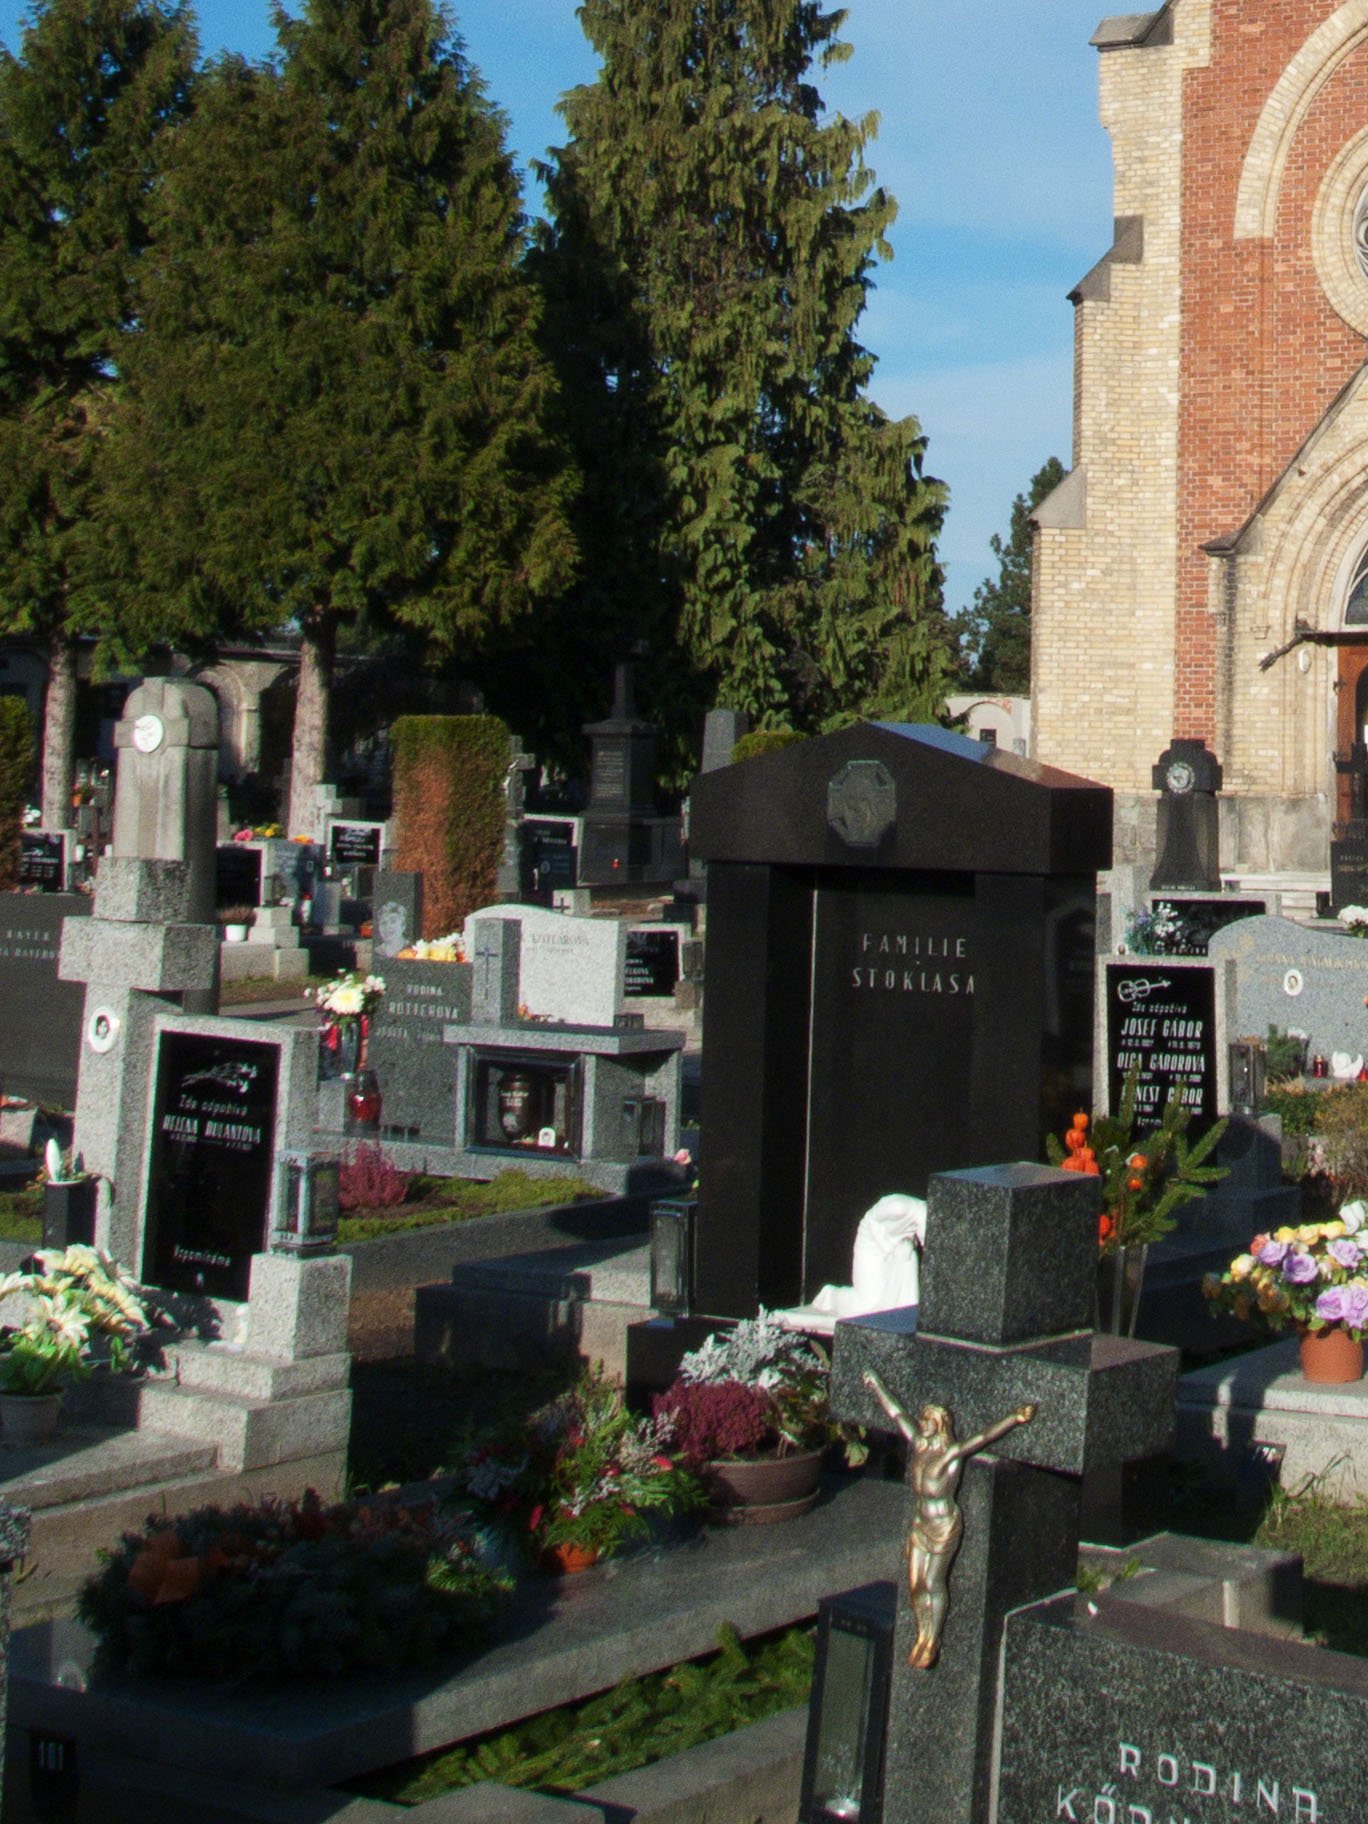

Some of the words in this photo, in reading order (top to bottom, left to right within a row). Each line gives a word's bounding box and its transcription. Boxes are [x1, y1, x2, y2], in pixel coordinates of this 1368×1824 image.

[861, 933, 967, 958] FAMILIE
[852, 968, 975, 995] STOKLASA
[1121, 1018, 1157, 1036] JOSEF
[1162, 1016, 1203, 1038] GÁBOR
[1167, 1086, 1203, 1105] GBOR
[1119, 1742, 1324, 1824] RODINA
